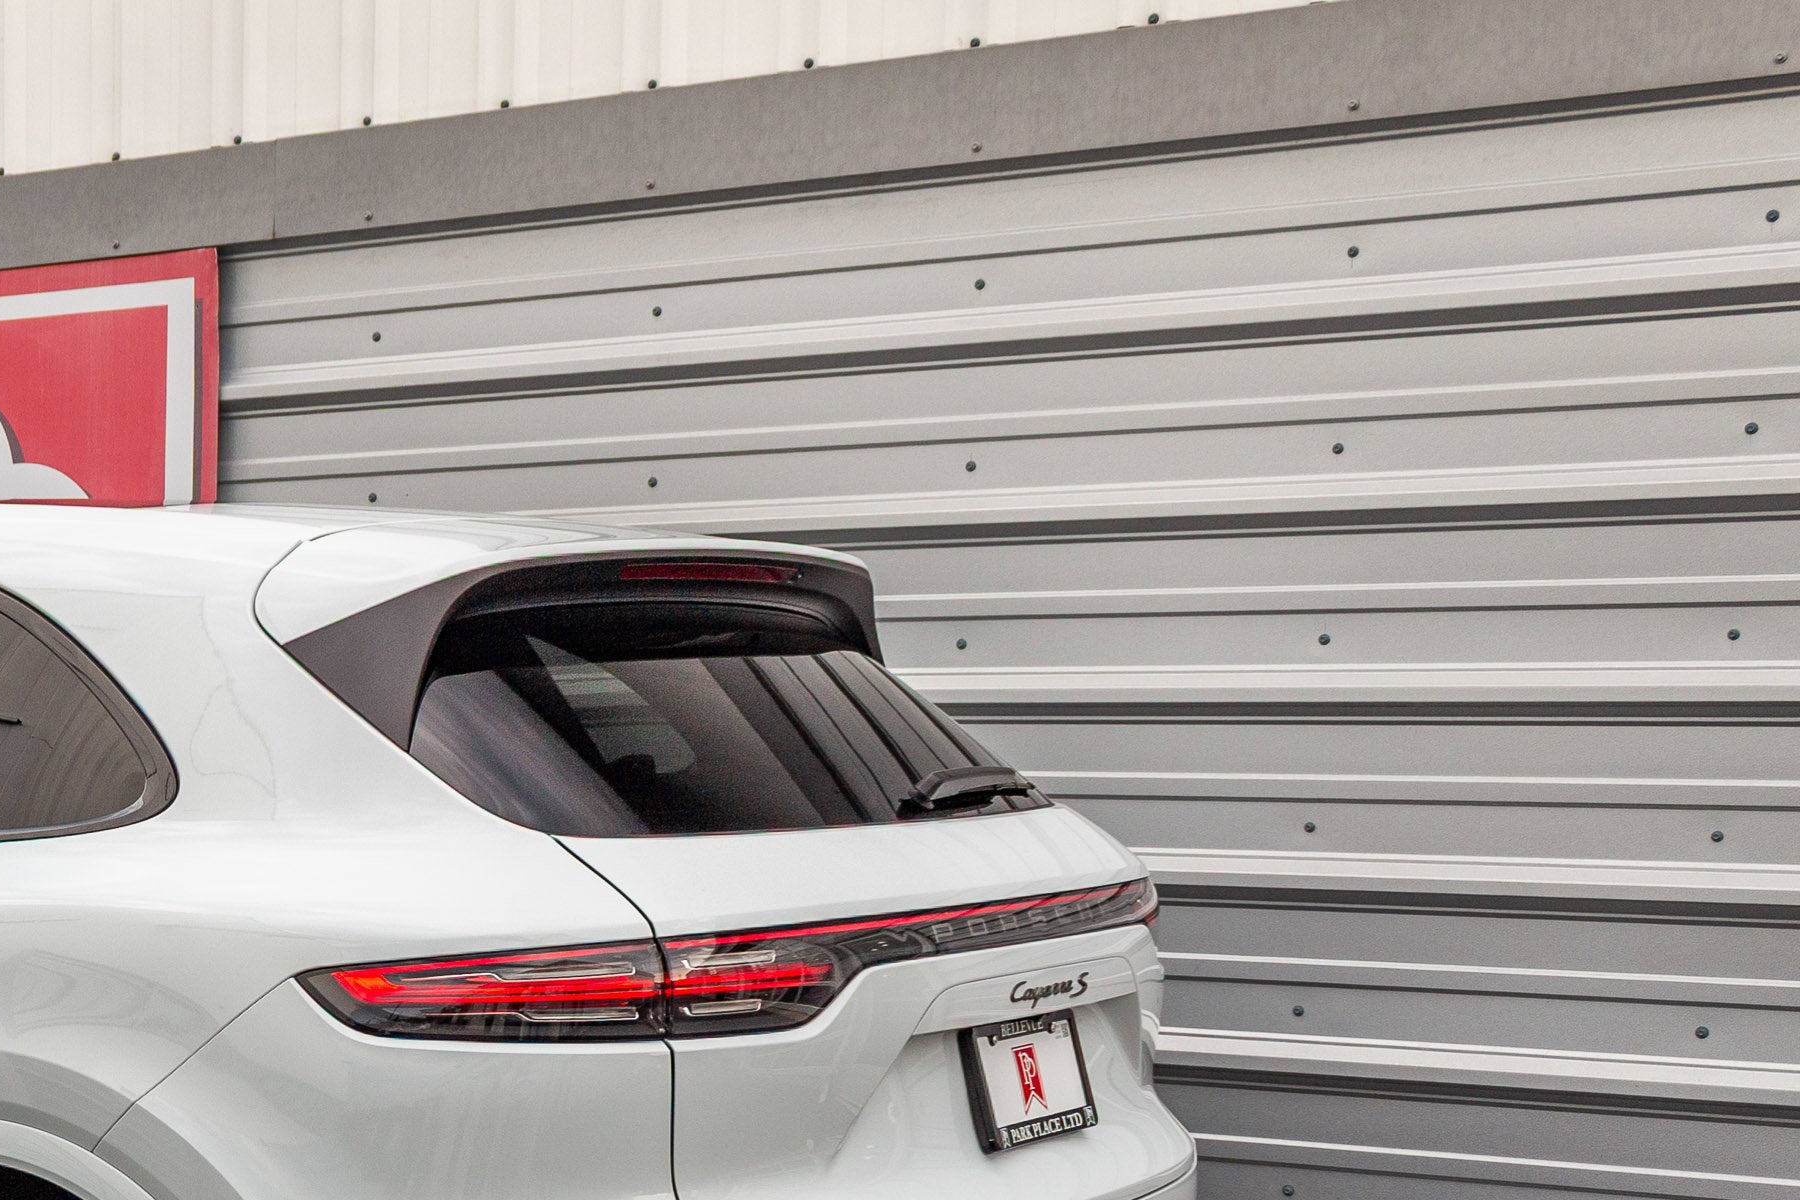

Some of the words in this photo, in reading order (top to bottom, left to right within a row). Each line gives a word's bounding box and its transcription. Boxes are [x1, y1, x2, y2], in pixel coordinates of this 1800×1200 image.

[1010, 980, 1074, 1009] Cayenne
[1069, 972, 1089, 998] S
[1010, 1124, 1034, 1144] PARK
[1032, 1117, 1063, 1138] PLACE
[1061, 1112, 1083, 1130] LTD
